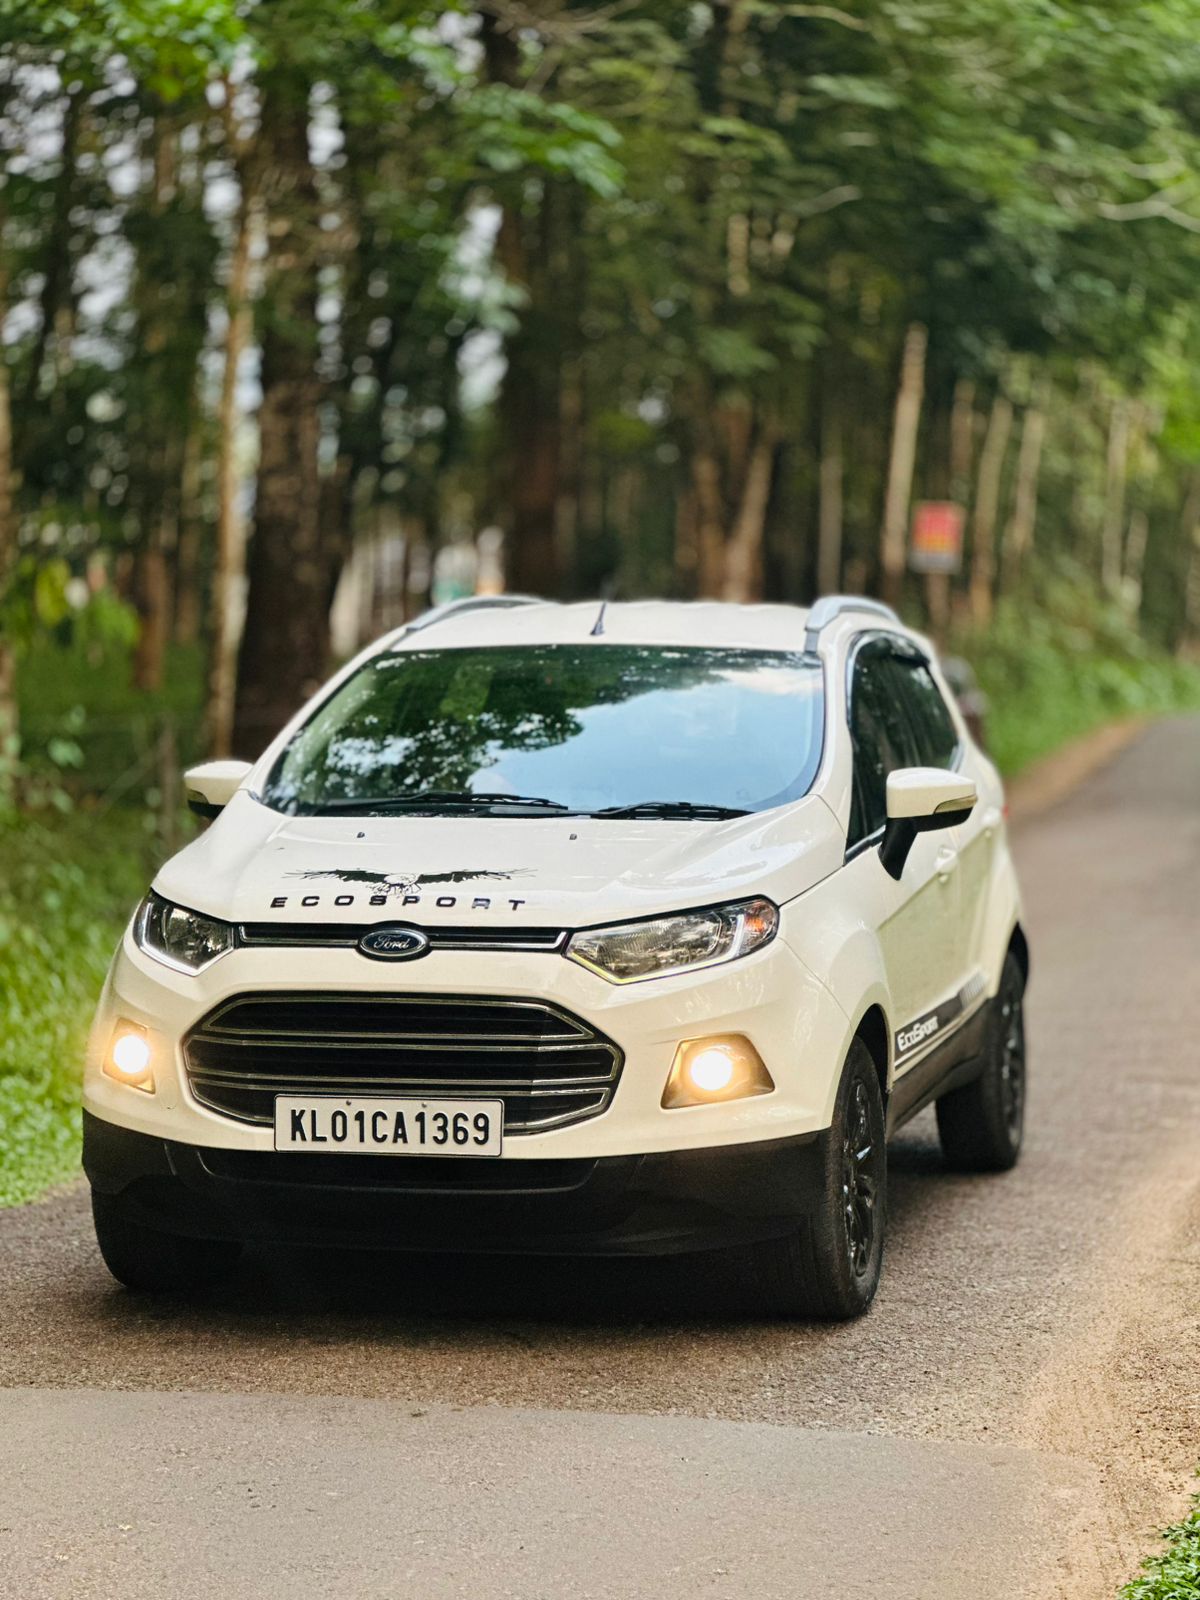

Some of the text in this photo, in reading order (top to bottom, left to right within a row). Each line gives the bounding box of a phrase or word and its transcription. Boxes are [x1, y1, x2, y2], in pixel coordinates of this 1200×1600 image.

[270, 895, 525, 911] ECOSPORT
[373, 934, 410, 949] Ford
[290, 1109, 490, 1146] KL01CA1369
